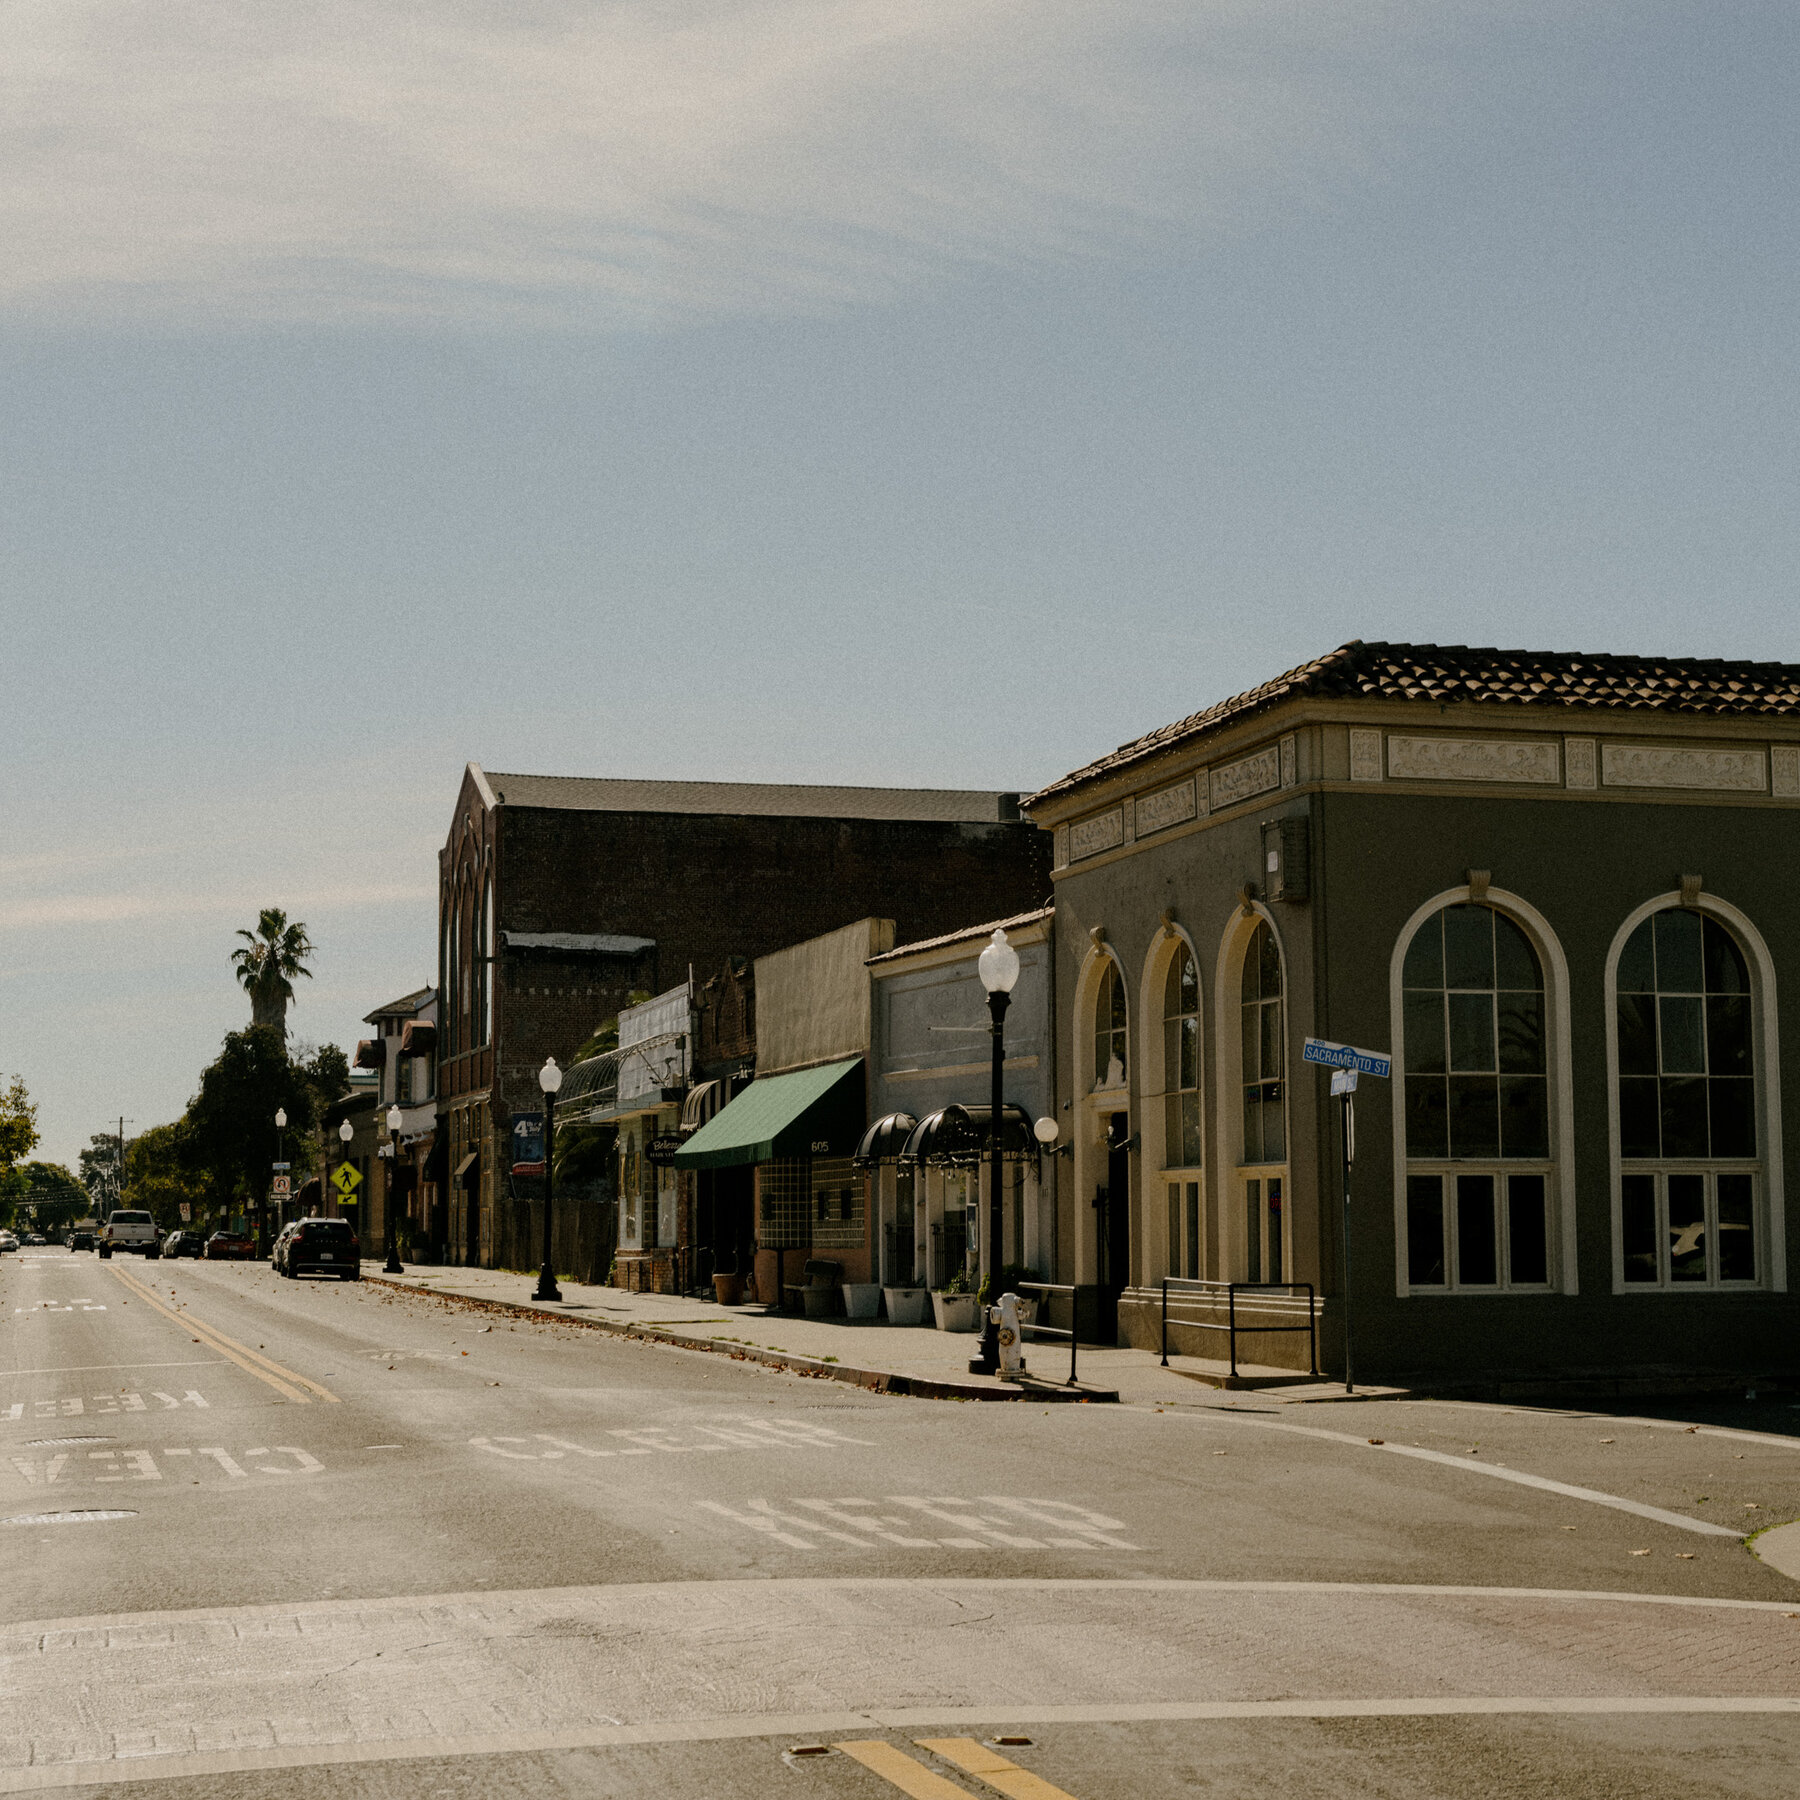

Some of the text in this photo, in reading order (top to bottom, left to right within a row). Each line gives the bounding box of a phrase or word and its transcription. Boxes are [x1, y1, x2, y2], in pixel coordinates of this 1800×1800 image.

[1306, 1046, 1387, 1074] SACRAMENTO ST
[811, 1141, 829, 1152] 605
[1270, 1198, 1282, 1209] OPE
[467, 1418, 878, 1460] CLEAR
[9, 1446, 326, 1484] CLEA
[695, 1495, 1150, 1550] KEEP
